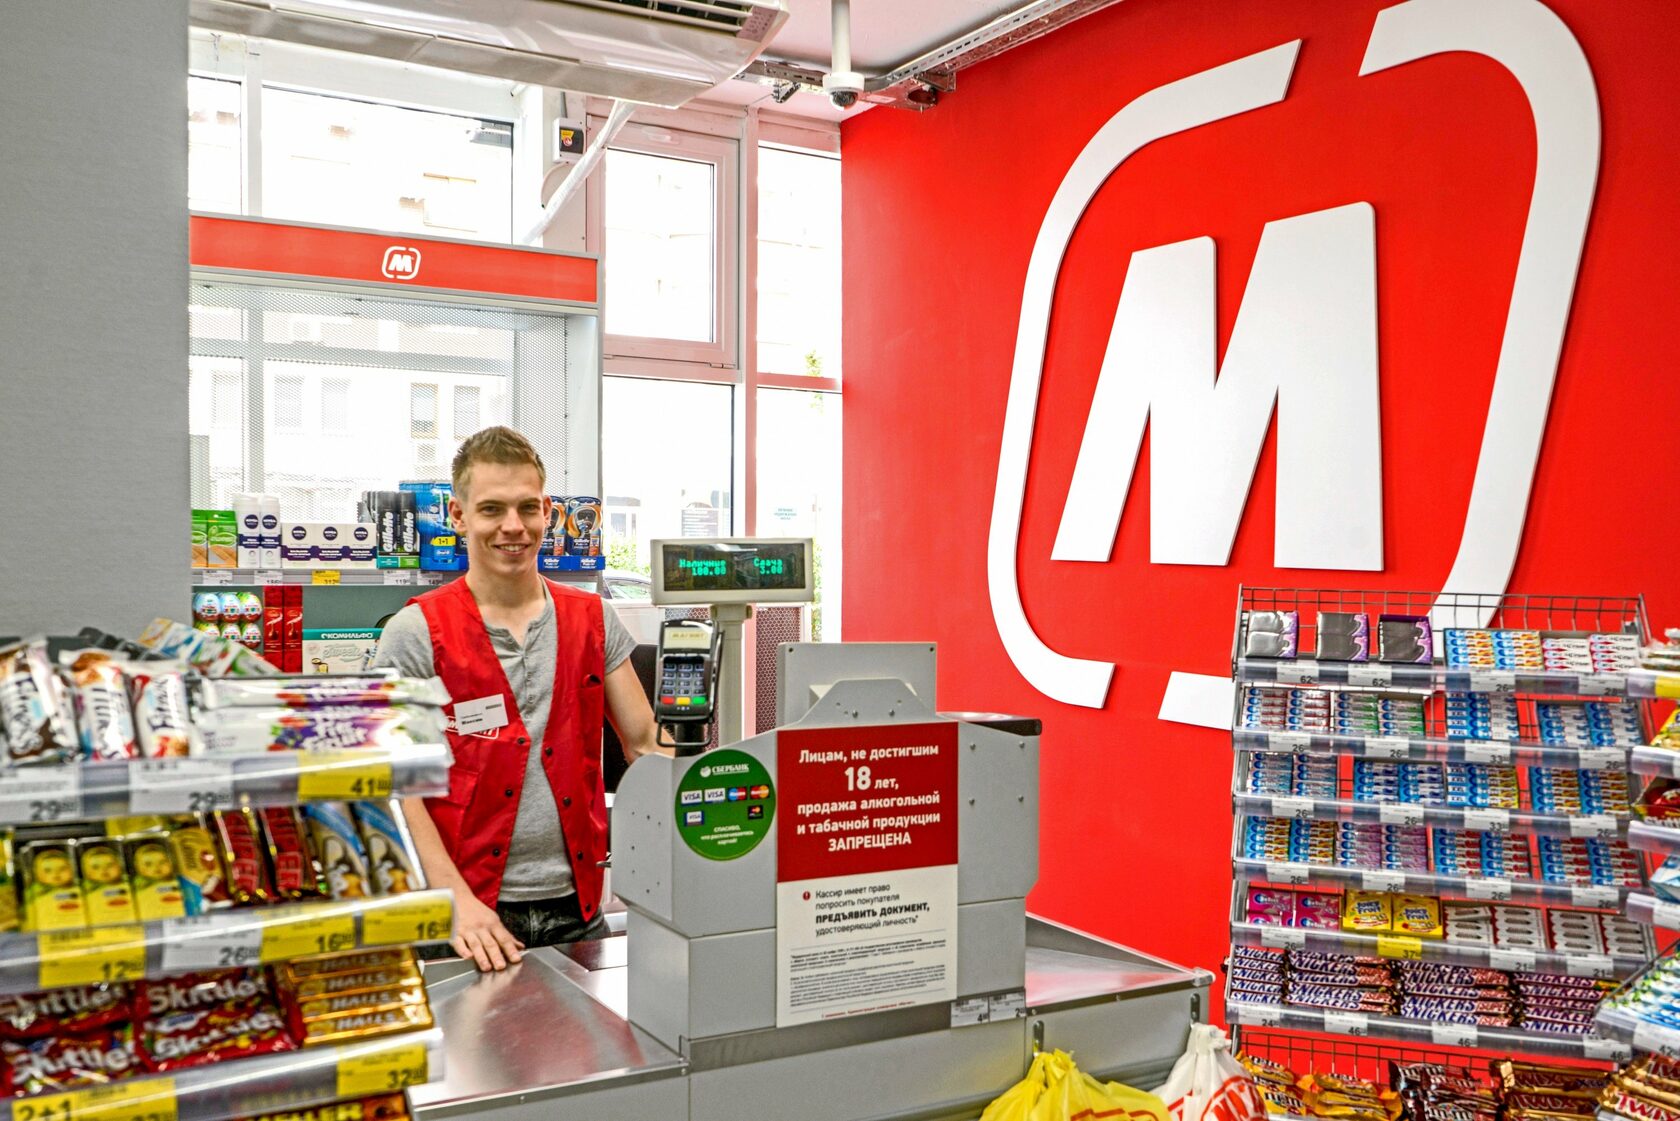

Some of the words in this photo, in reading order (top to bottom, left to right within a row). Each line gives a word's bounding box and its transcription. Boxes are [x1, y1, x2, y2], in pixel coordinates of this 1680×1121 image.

[1051, 201, 1385, 572] M
[799, 750, 847, 764] Лицам,
[851, 750, 867, 761] не
[869, 745, 939, 761] достигшим
[712, 763, 750, 774] СБЕРБАНК
[844, 766, 871, 791] 18
[874, 778, 899, 790] лет,
[684, 792, 700, 801] VISA
[708, 790, 724, 799] VISA
[797, 799, 857, 817] продажа
[860, 790, 940, 810] алкогольной
[797, 824, 806, 835] и
[808, 816, 869, 834] табачной
[872, 812, 940, 830] продукции
[828, 831, 912, 852] ЗАПРЕЩЕНА
[815, 889, 843, 899] Кассир
[844, 886, 867, 895] имеет
[868, 884, 891, 893] право
[815, 898, 855, 910] попросить
[857, 894, 900, 906] покупателя
[815, 909, 878, 924] ПРЕДЪЯВИТЬ
[879, 902, 930, 917] ДОКУМЕНТ,
[815, 920, 881, 938] удостоверяющий
[1289, 982, 1362, 1001] SNICKERS
[1401, 1006, 1478, 1025] SNICKERS
